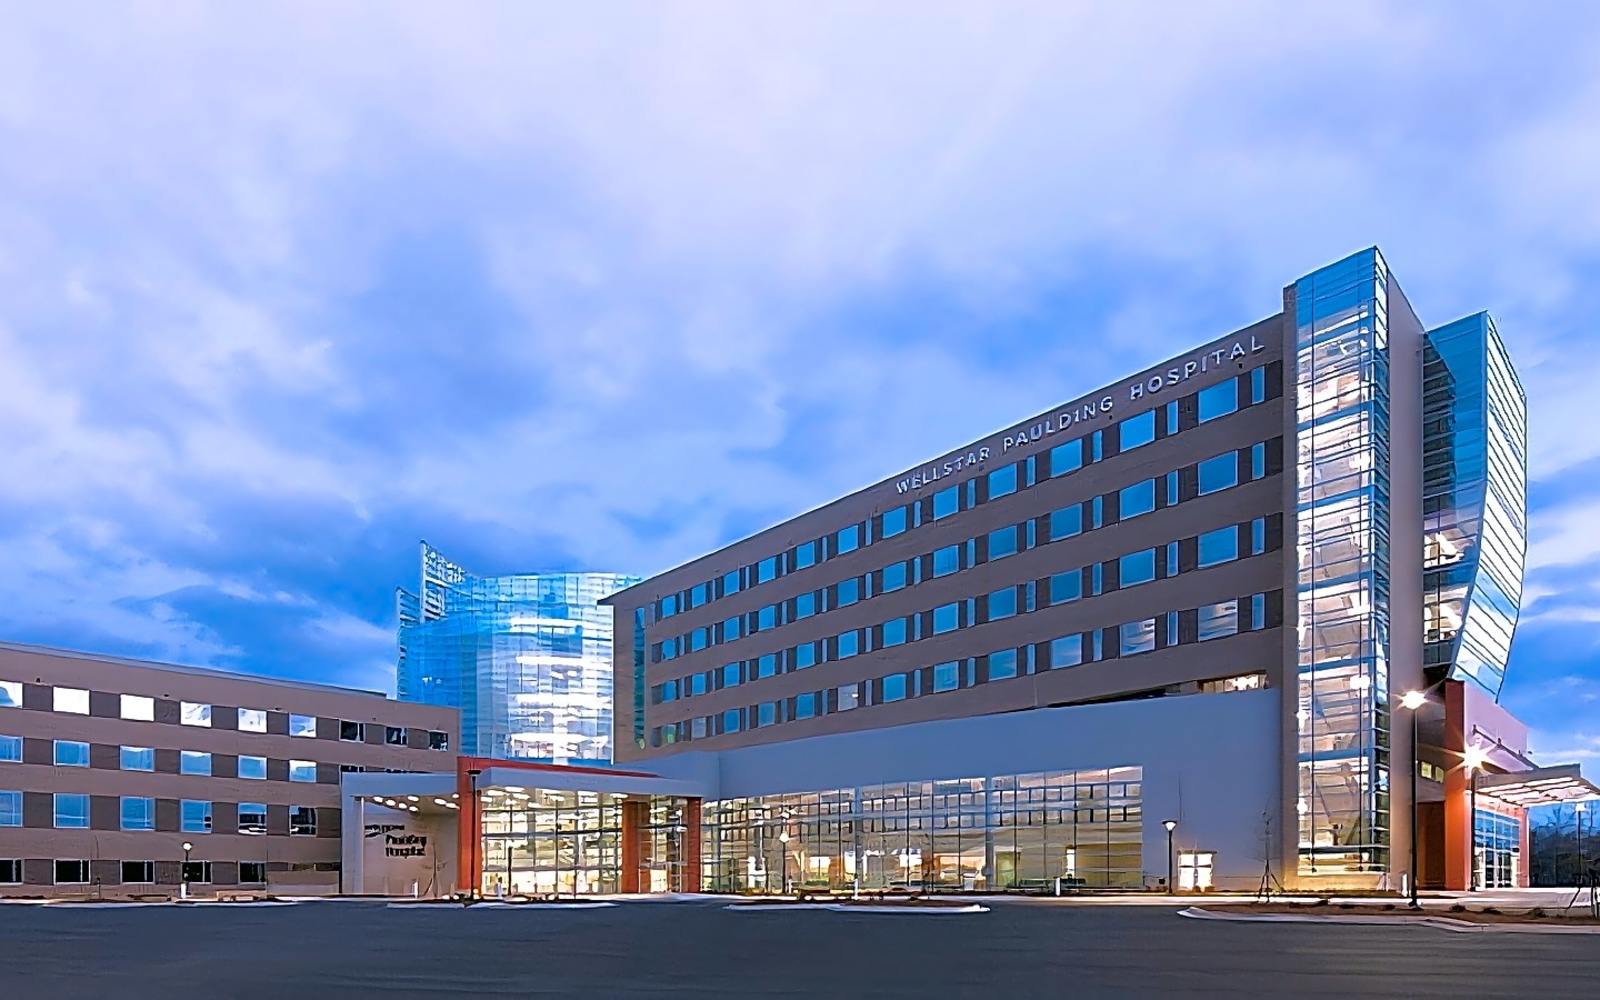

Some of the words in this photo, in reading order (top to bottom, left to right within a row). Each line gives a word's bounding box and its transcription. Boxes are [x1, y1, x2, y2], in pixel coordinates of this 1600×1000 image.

[896, 447, 990, 494] WELLSTAR
[1002, 397, 1113, 452] PAULDING
[1129, 335, 1265, 400] HOSPITAL
